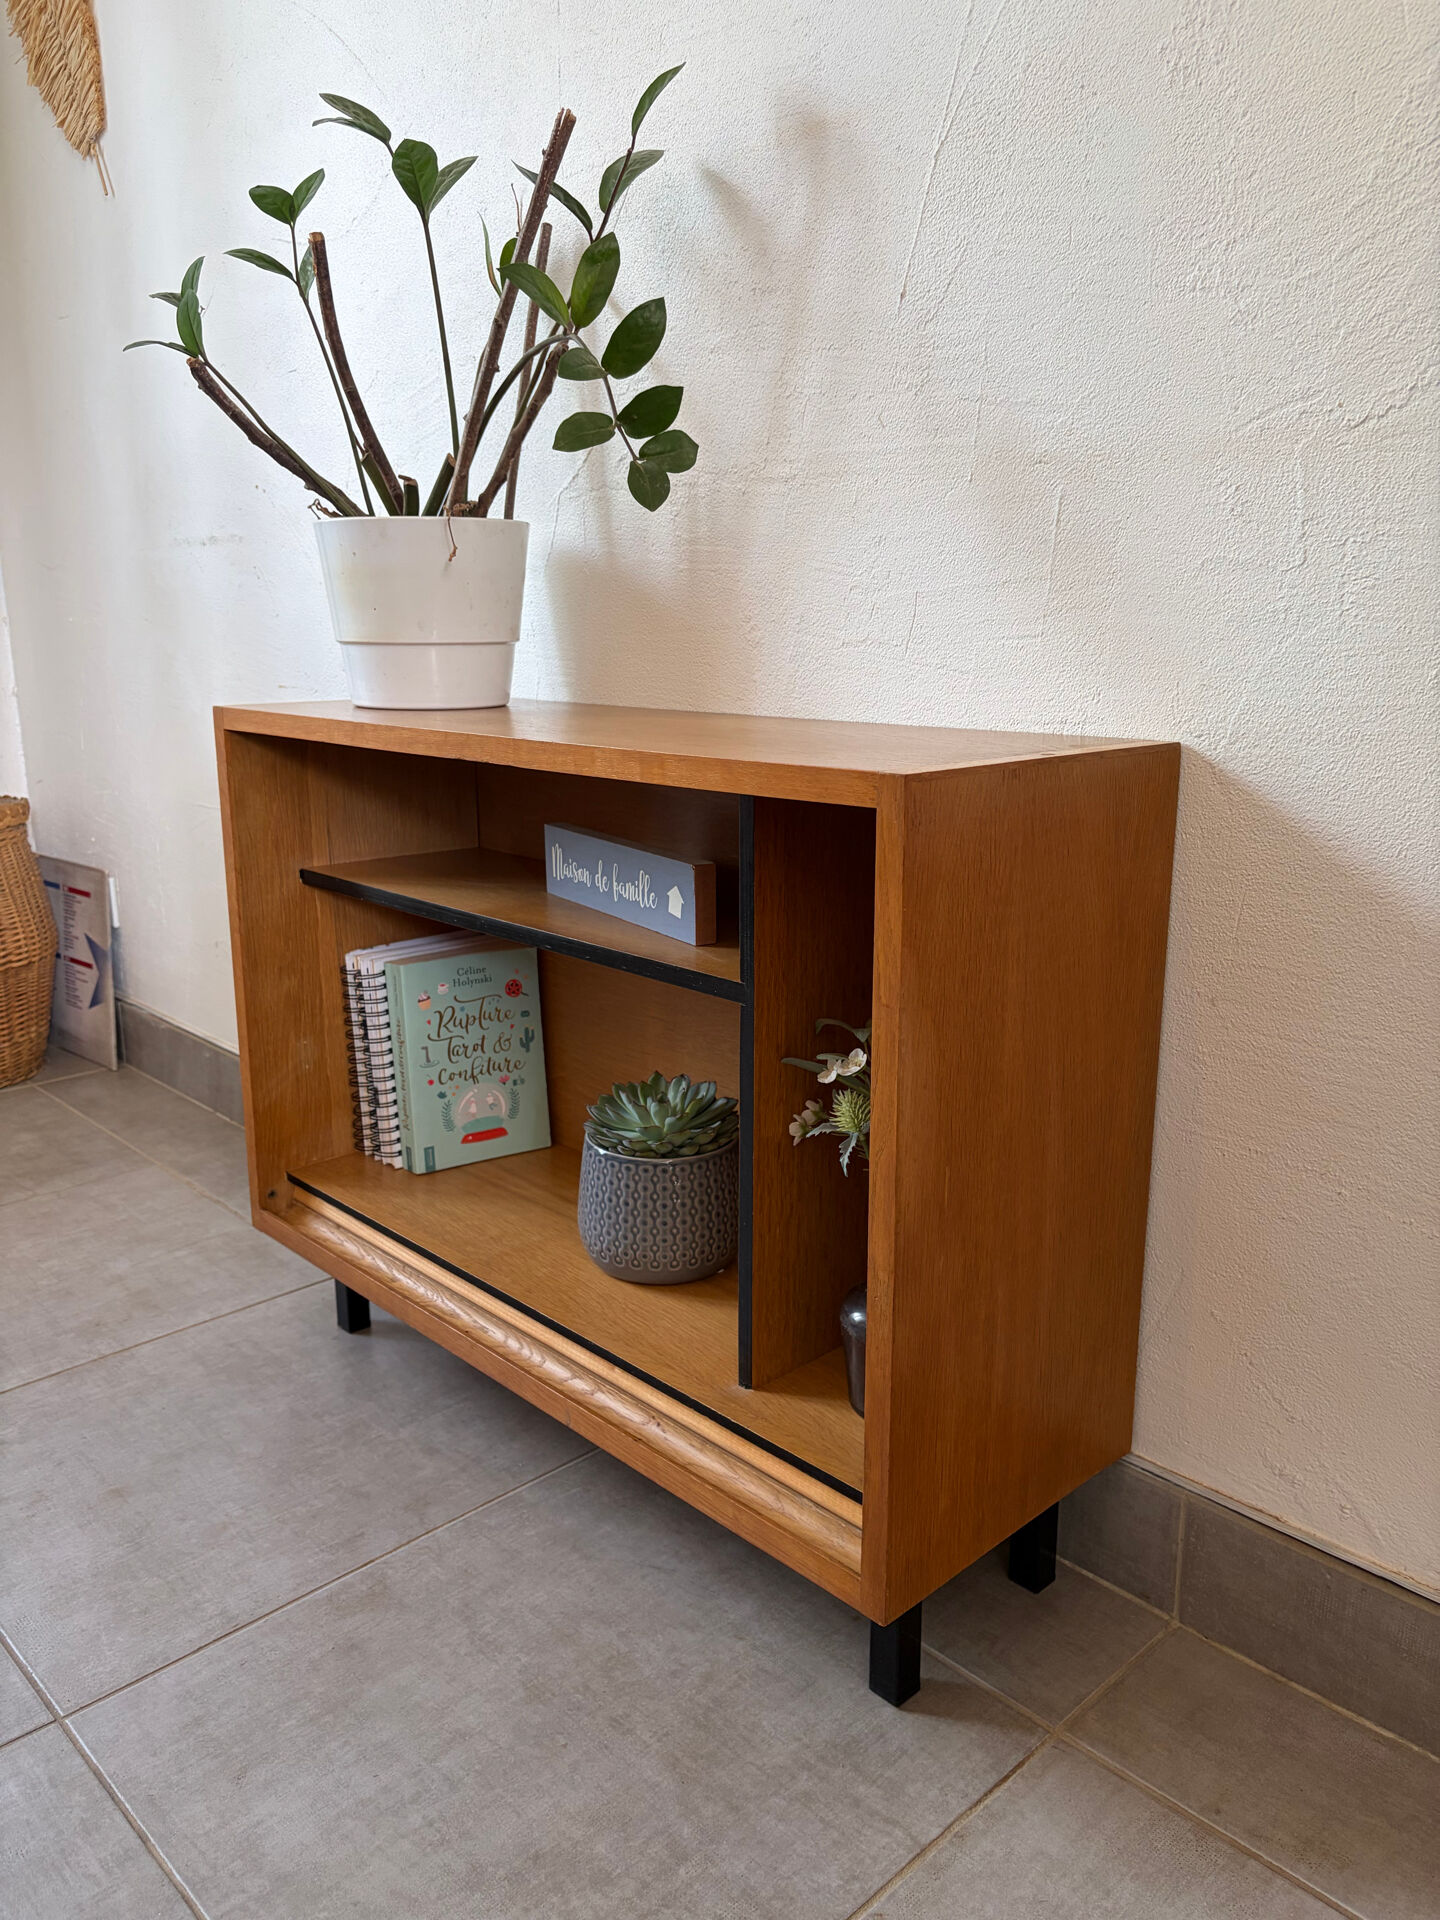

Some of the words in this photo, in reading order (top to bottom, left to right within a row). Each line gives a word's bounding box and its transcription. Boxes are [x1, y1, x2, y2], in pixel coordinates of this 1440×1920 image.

[551, 843, 592, 888] Maison
[594, 860, 610, 893] de
[612, 863, 658, 909] famille
[453, 974, 493, 989] Holynski
[457, 966, 487, 977] Céline
[434, 994, 516, 1039] Rupture
[427, 1033, 486, 1064] Tarot
[493, 1031, 512, 1054] &
